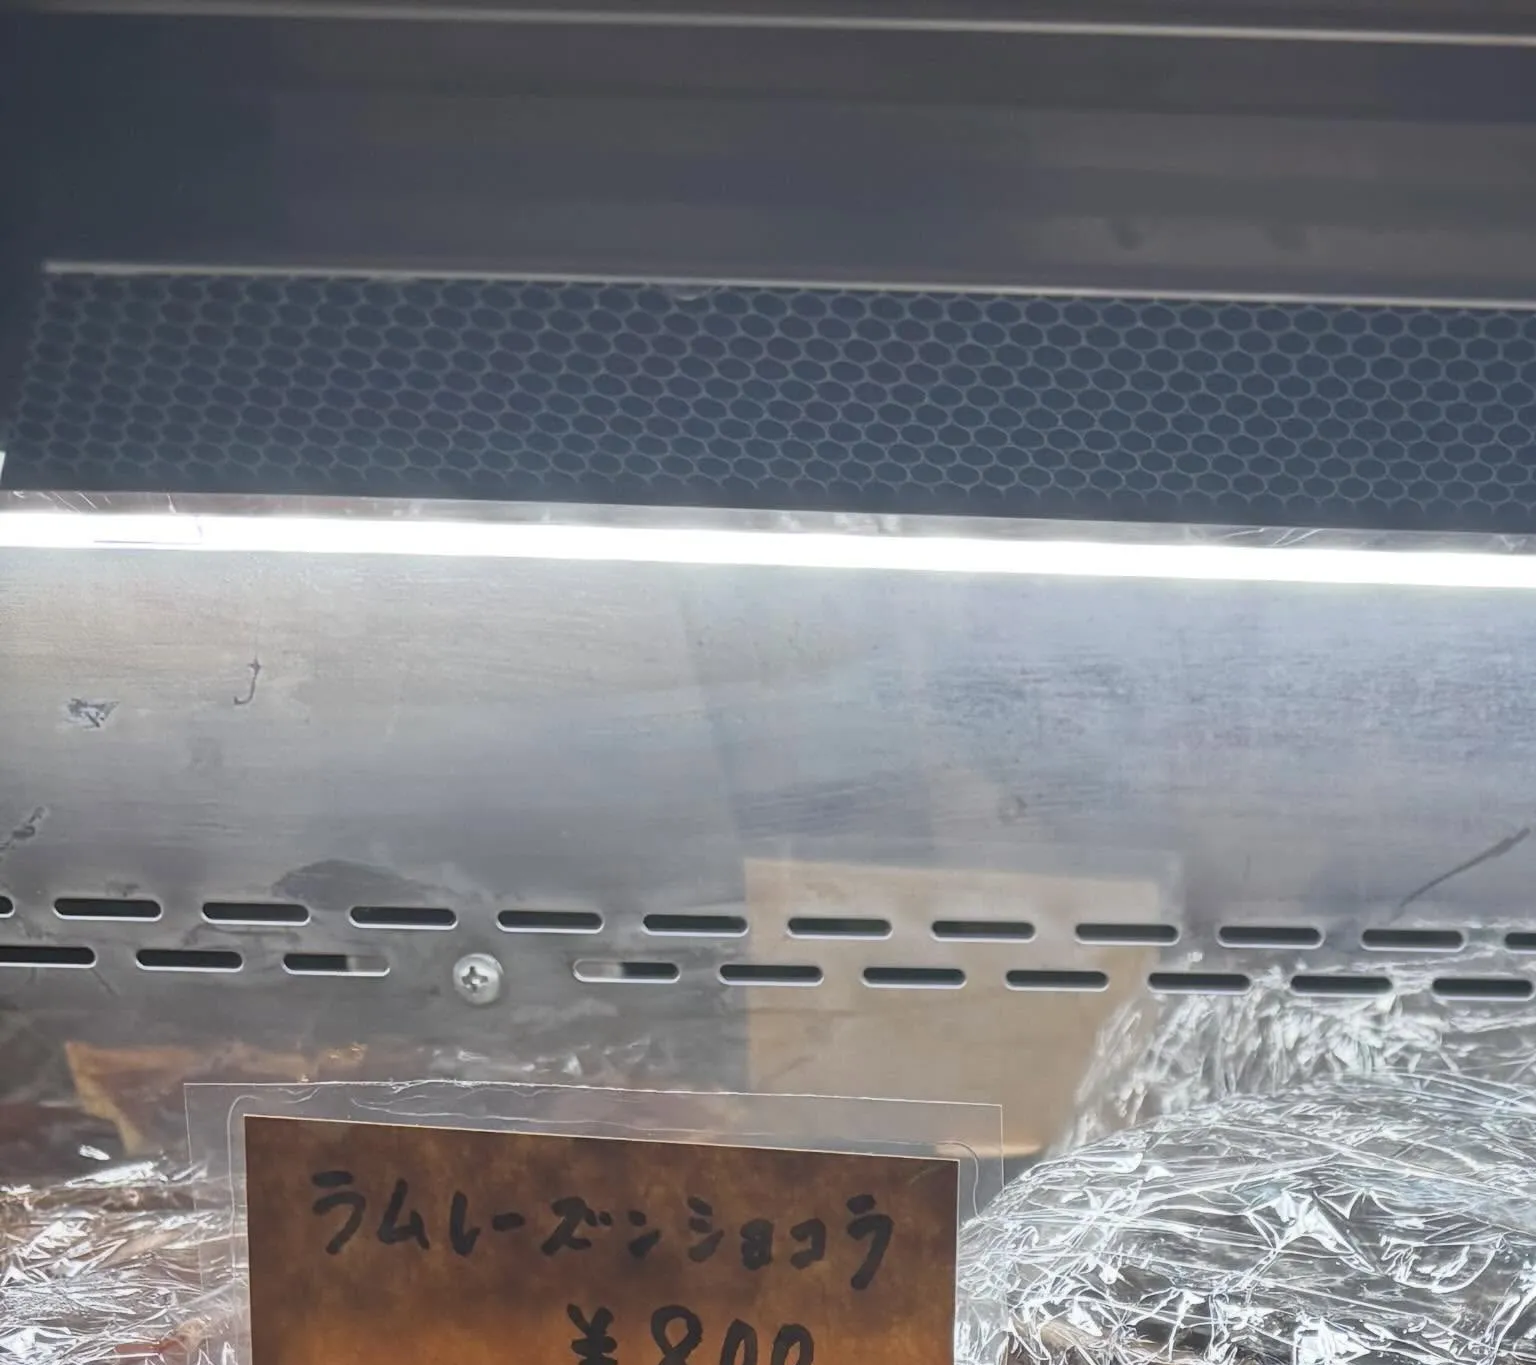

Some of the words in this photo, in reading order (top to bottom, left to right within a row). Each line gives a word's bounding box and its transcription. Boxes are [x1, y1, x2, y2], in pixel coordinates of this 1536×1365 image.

[311, 1171, 895, 1290] ラムレーズンショコラ
